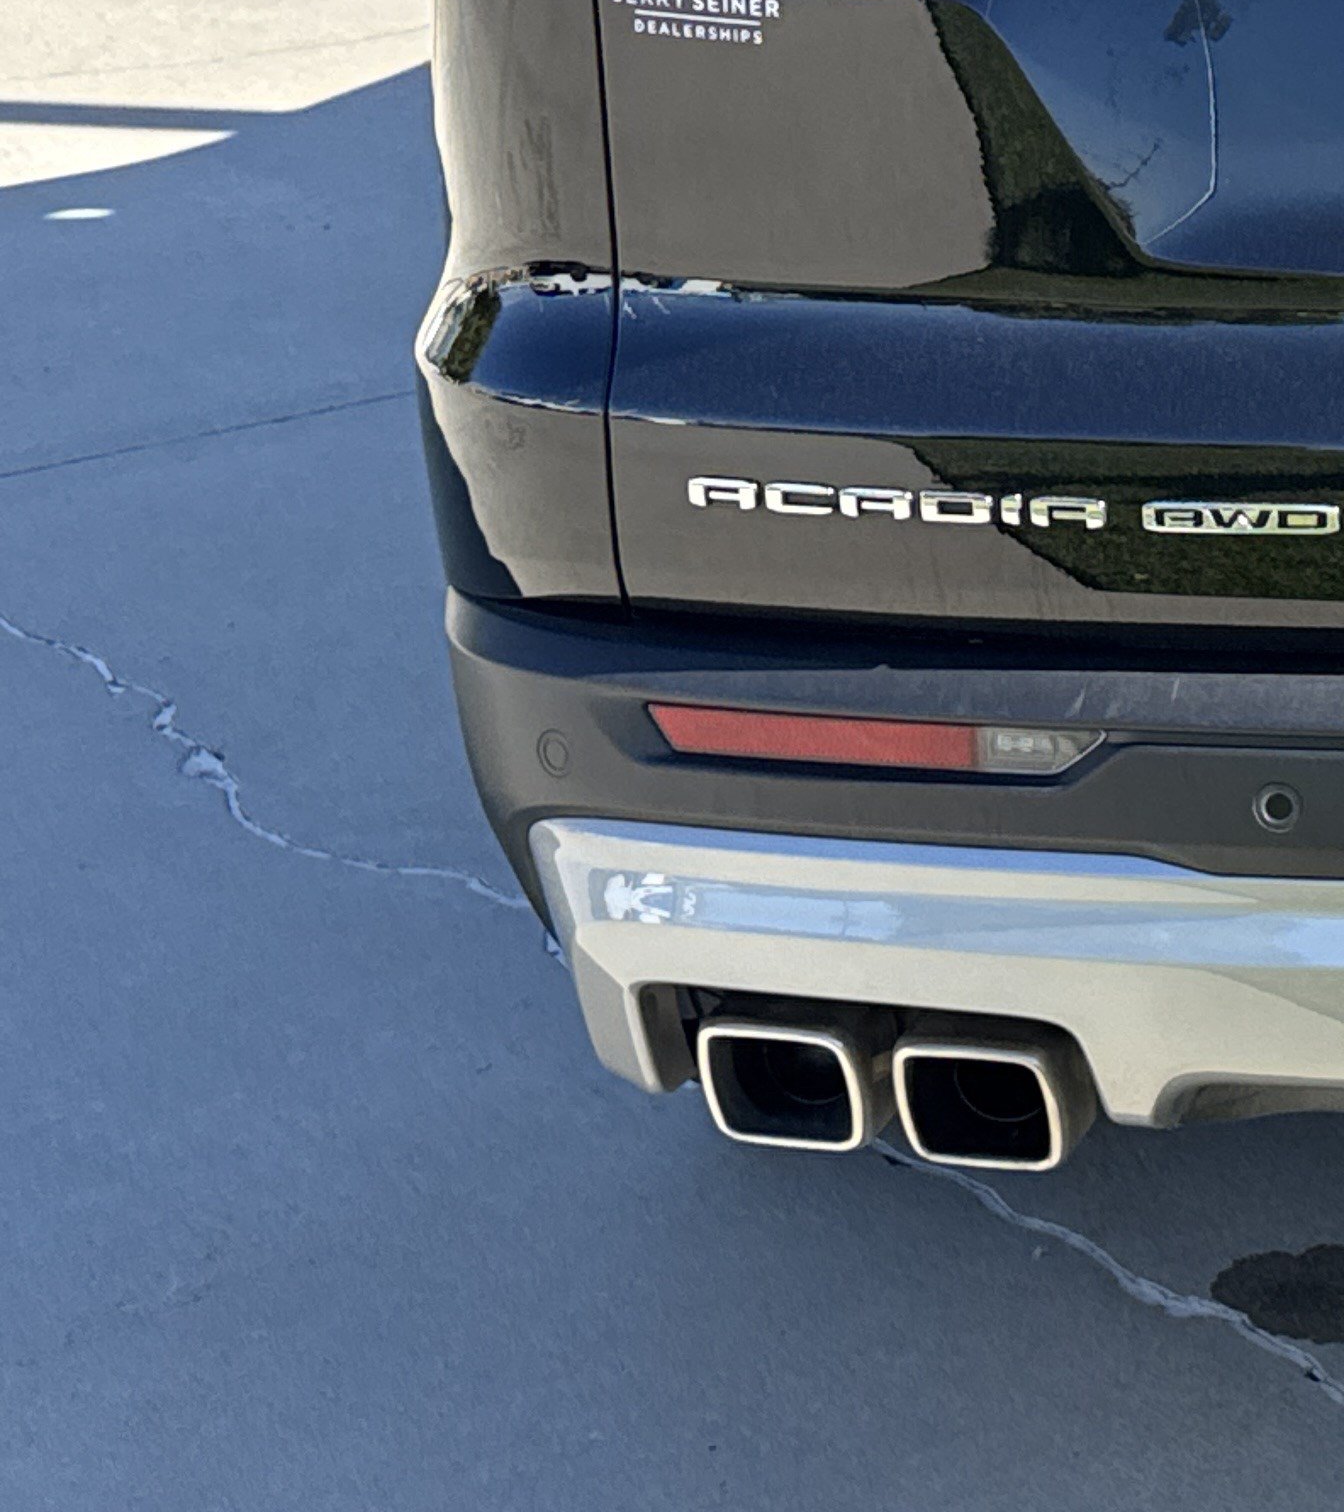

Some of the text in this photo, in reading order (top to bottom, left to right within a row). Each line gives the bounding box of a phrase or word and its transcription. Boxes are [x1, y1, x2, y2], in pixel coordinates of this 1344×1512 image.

[633, 18, 763, 45] DEALERSHIPS
[688, 476, 1329, 530] ACADIA AWD
